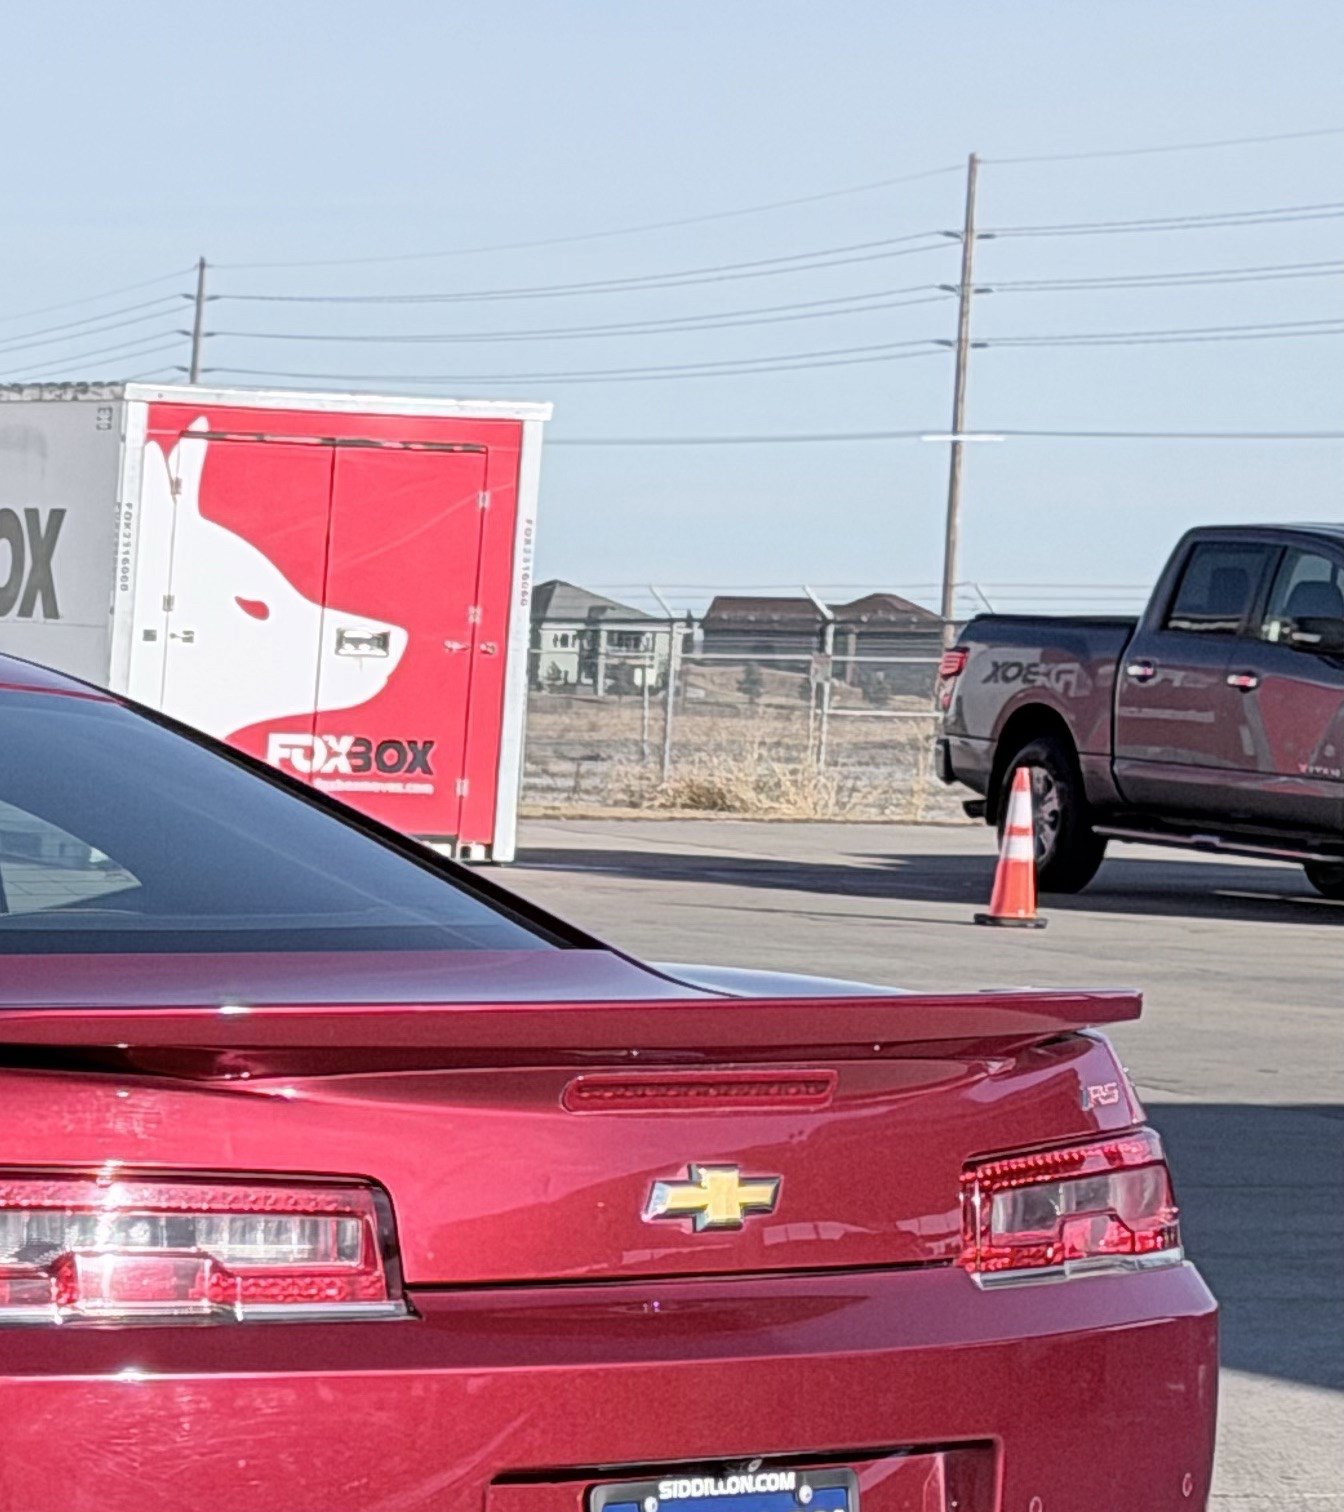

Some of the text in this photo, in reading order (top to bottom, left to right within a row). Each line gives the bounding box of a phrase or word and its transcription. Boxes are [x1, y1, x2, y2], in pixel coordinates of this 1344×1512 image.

[266, 733, 434, 775] FOXBOX
[1083, 1082, 1119, 1111] RS
[658, 1471, 796, 1500] SIDDILLON.COM
